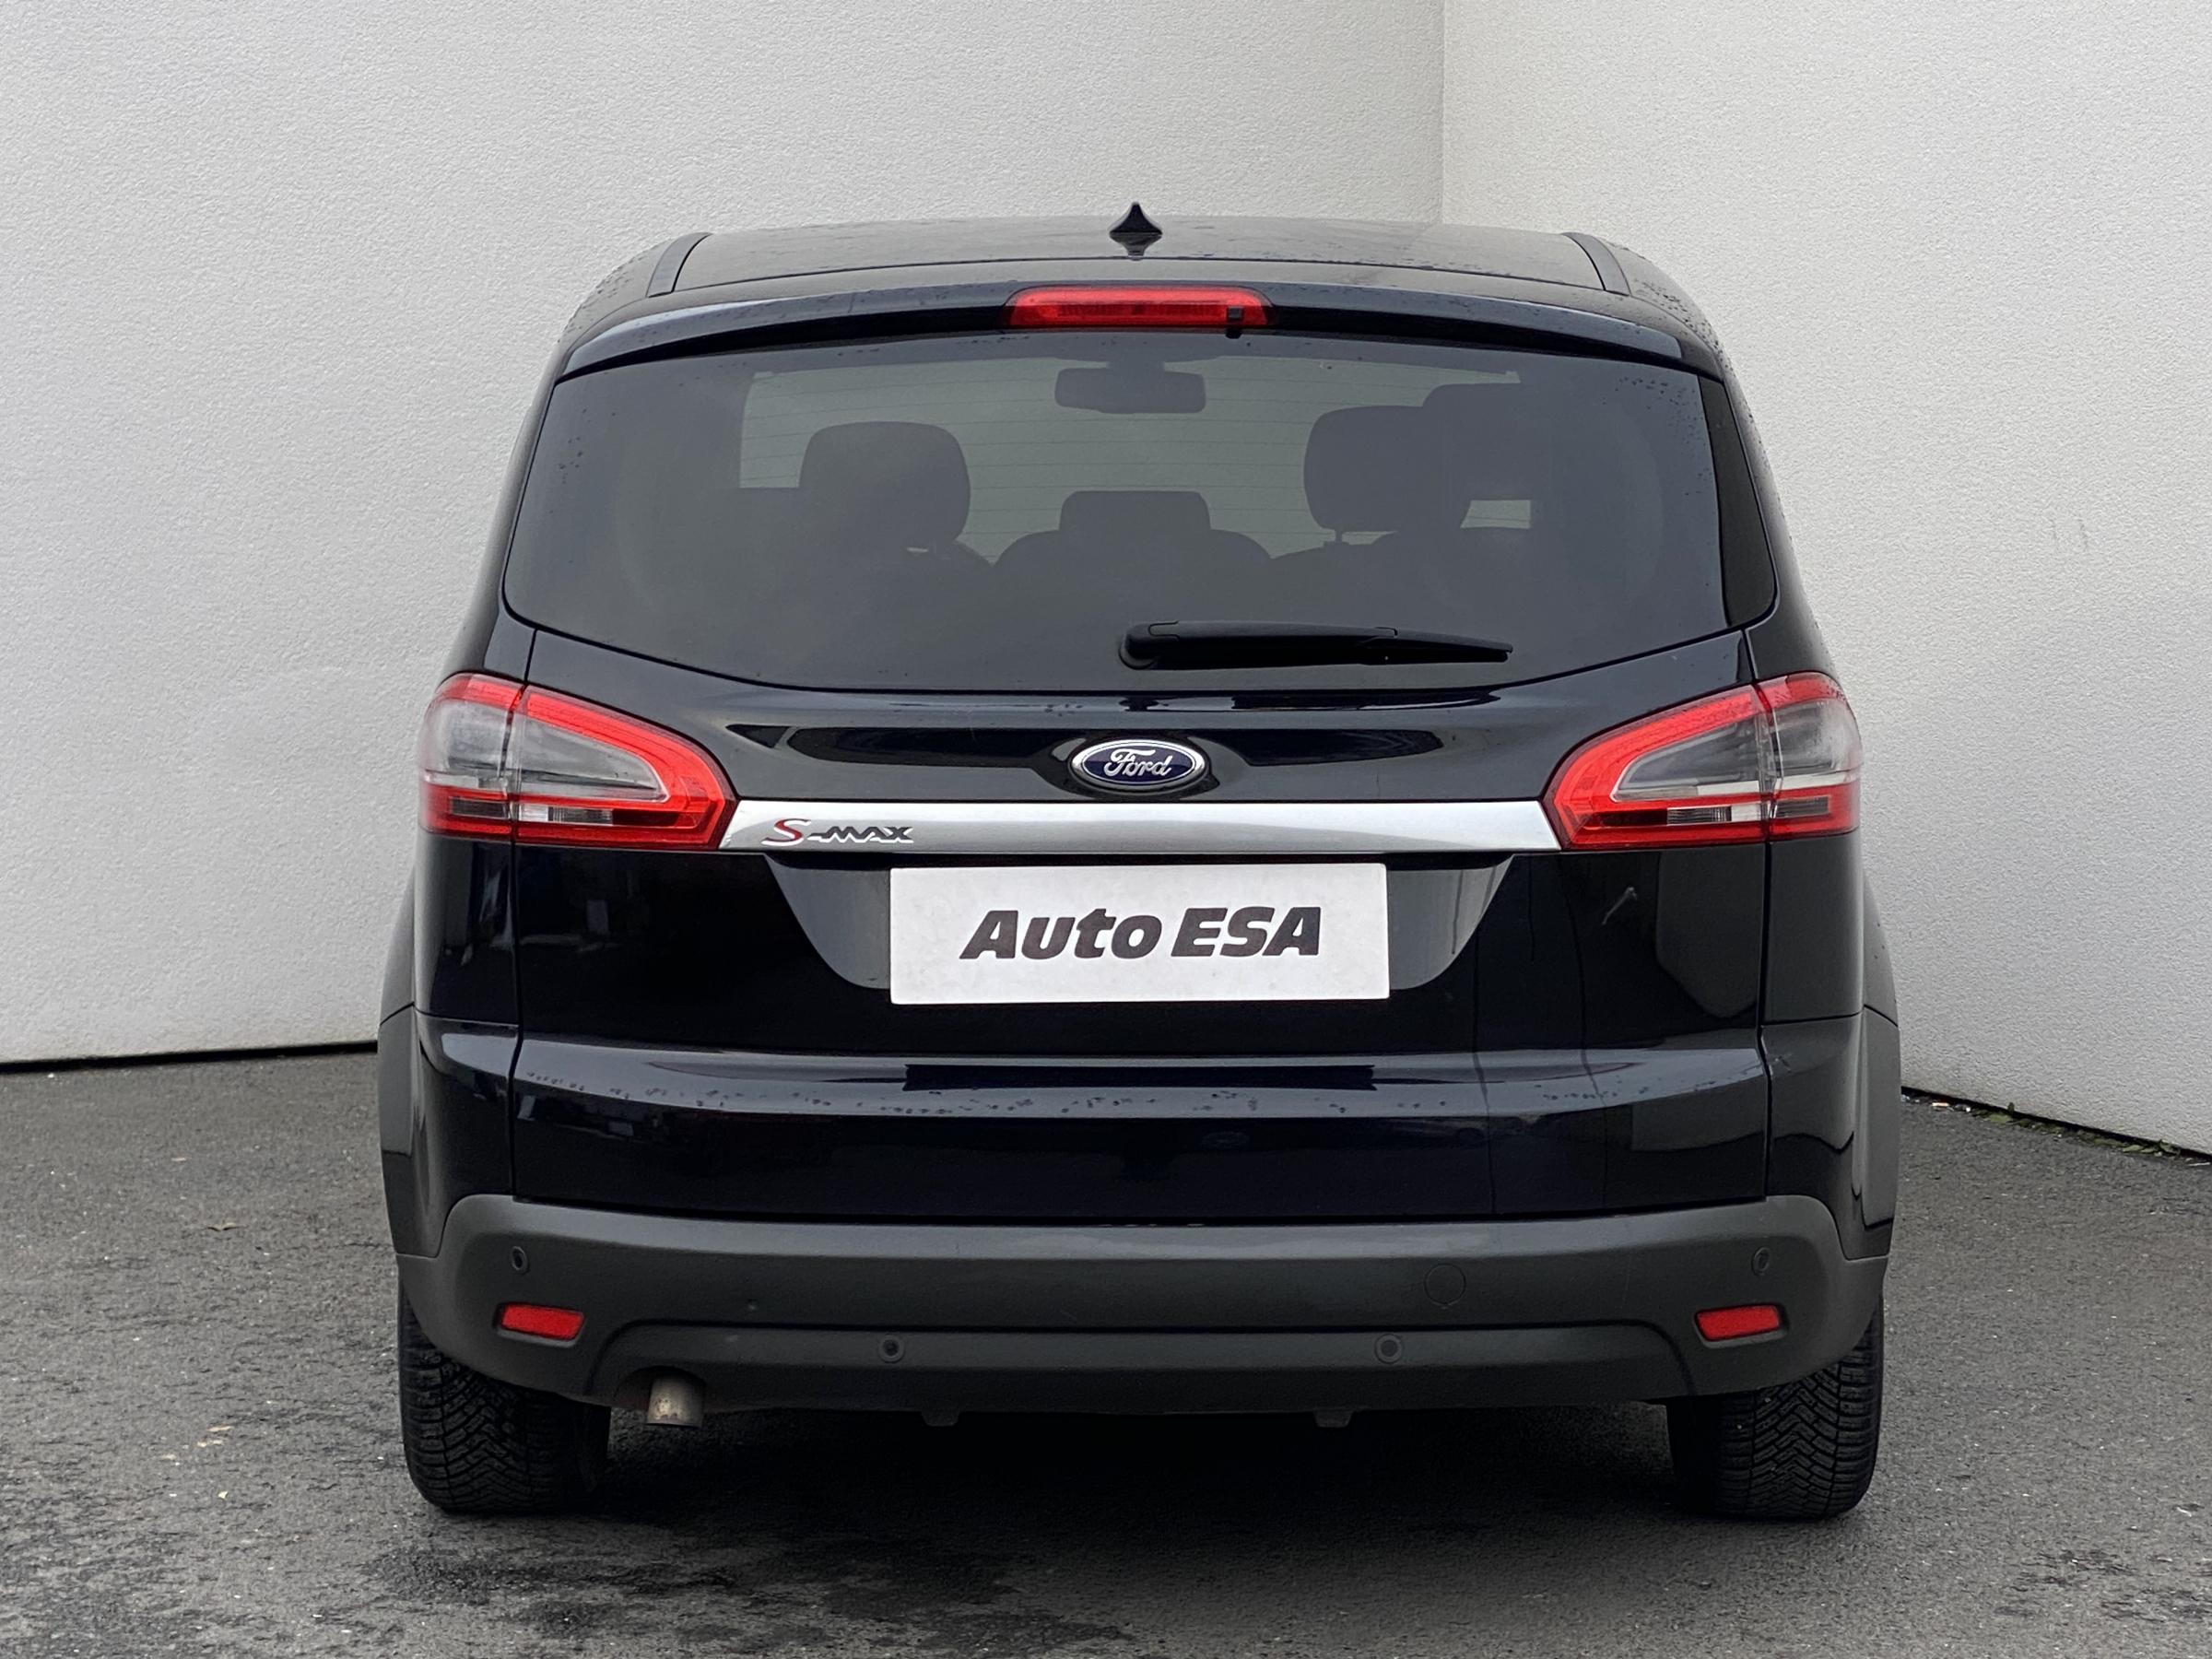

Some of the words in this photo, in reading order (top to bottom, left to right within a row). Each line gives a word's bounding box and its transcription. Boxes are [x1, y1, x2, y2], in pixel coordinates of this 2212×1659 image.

[1104, 747, 1173, 777] Ford
[761, 818, 914, 845] S-MAX
[959, 909, 1162, 959] Auto
[1171, 906, 1322, 957] ESA
